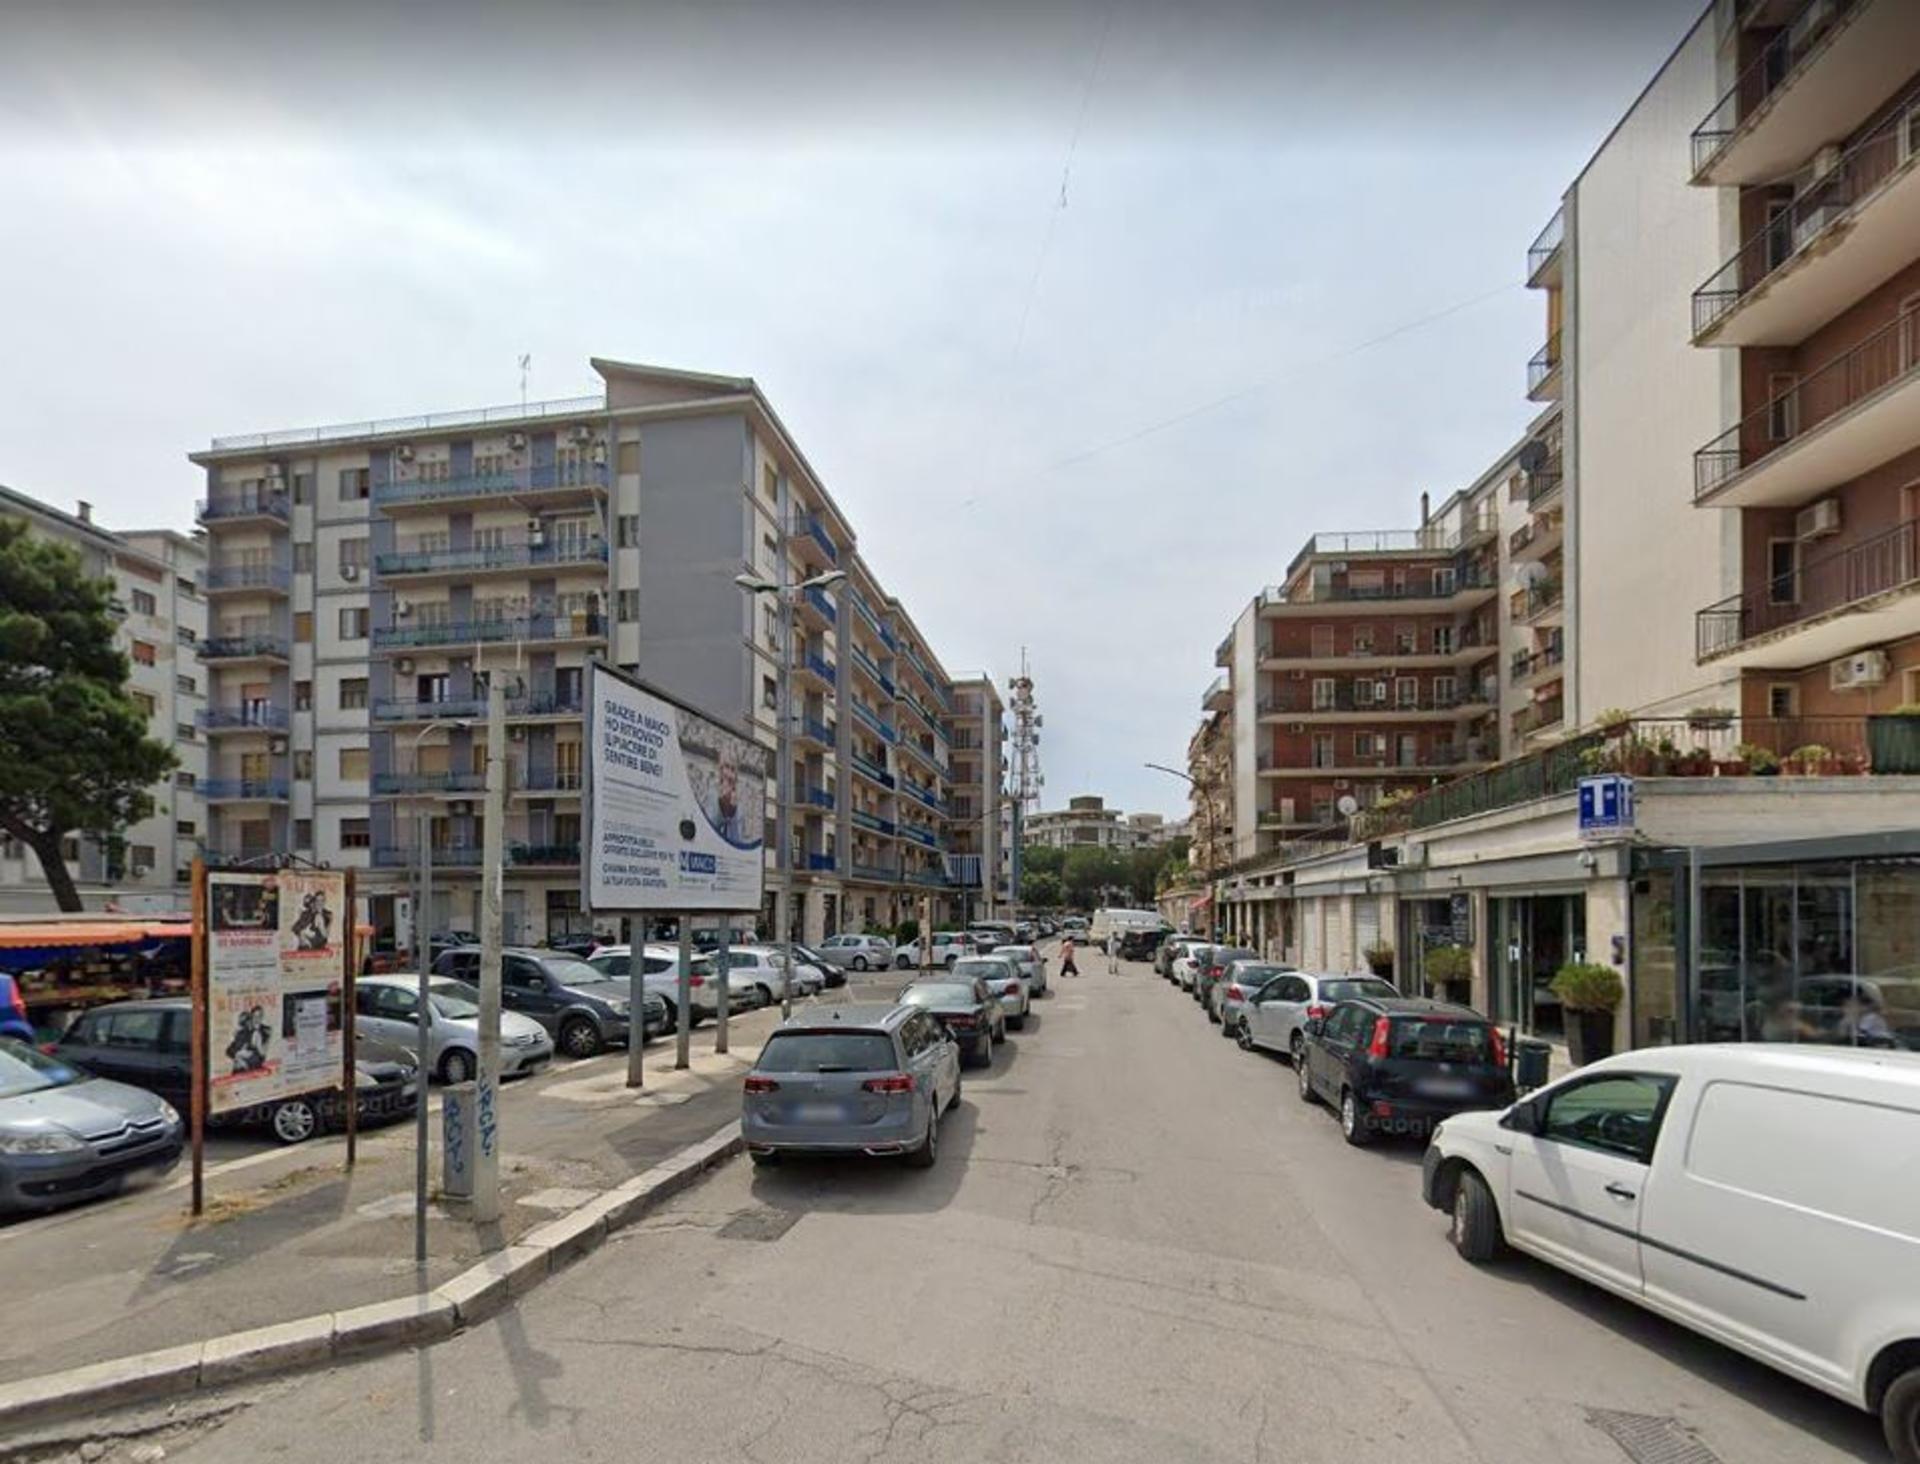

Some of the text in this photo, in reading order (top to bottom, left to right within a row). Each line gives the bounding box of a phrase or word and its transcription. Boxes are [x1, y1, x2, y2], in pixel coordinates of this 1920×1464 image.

[604, 700, 636, 723] GRAZIE
[637, 713, 643, 726] A
[604, 715, 664, 748] HO RITROVATO
[604, 747, 638, 770] SENTIRE
[613, 735, 647, 758] PIACERE
[648, 748, 658, 760] DI
